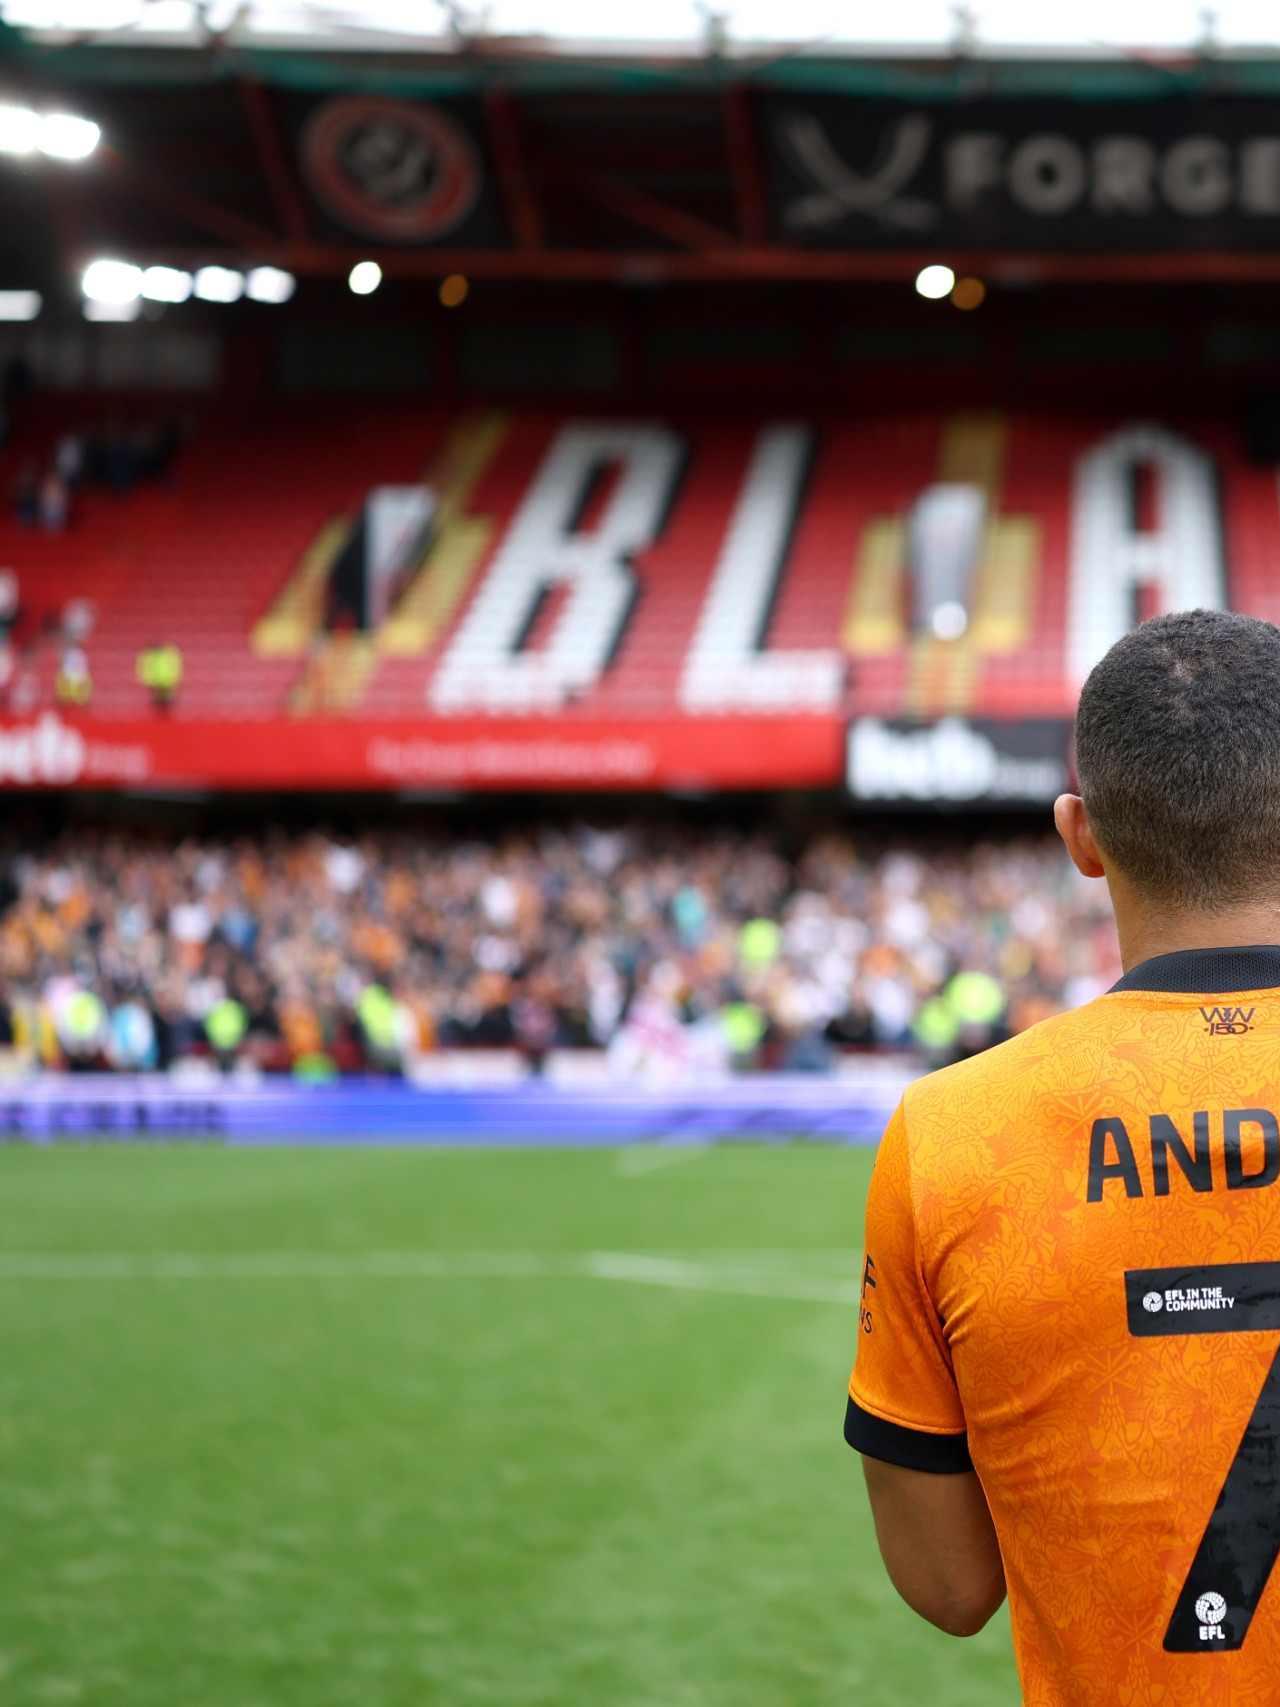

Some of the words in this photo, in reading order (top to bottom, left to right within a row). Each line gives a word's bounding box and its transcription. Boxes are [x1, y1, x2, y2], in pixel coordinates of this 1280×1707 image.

[1165, 1289, 1185, 1301] EFL
[1186, 1288, 1200, 1300] IN
[1201, 1286, 1222, 1299] THE
[1165, 1297, 1235, 1312] COMMUNITY
[1198, 1625, 1225, 1641] EFL
